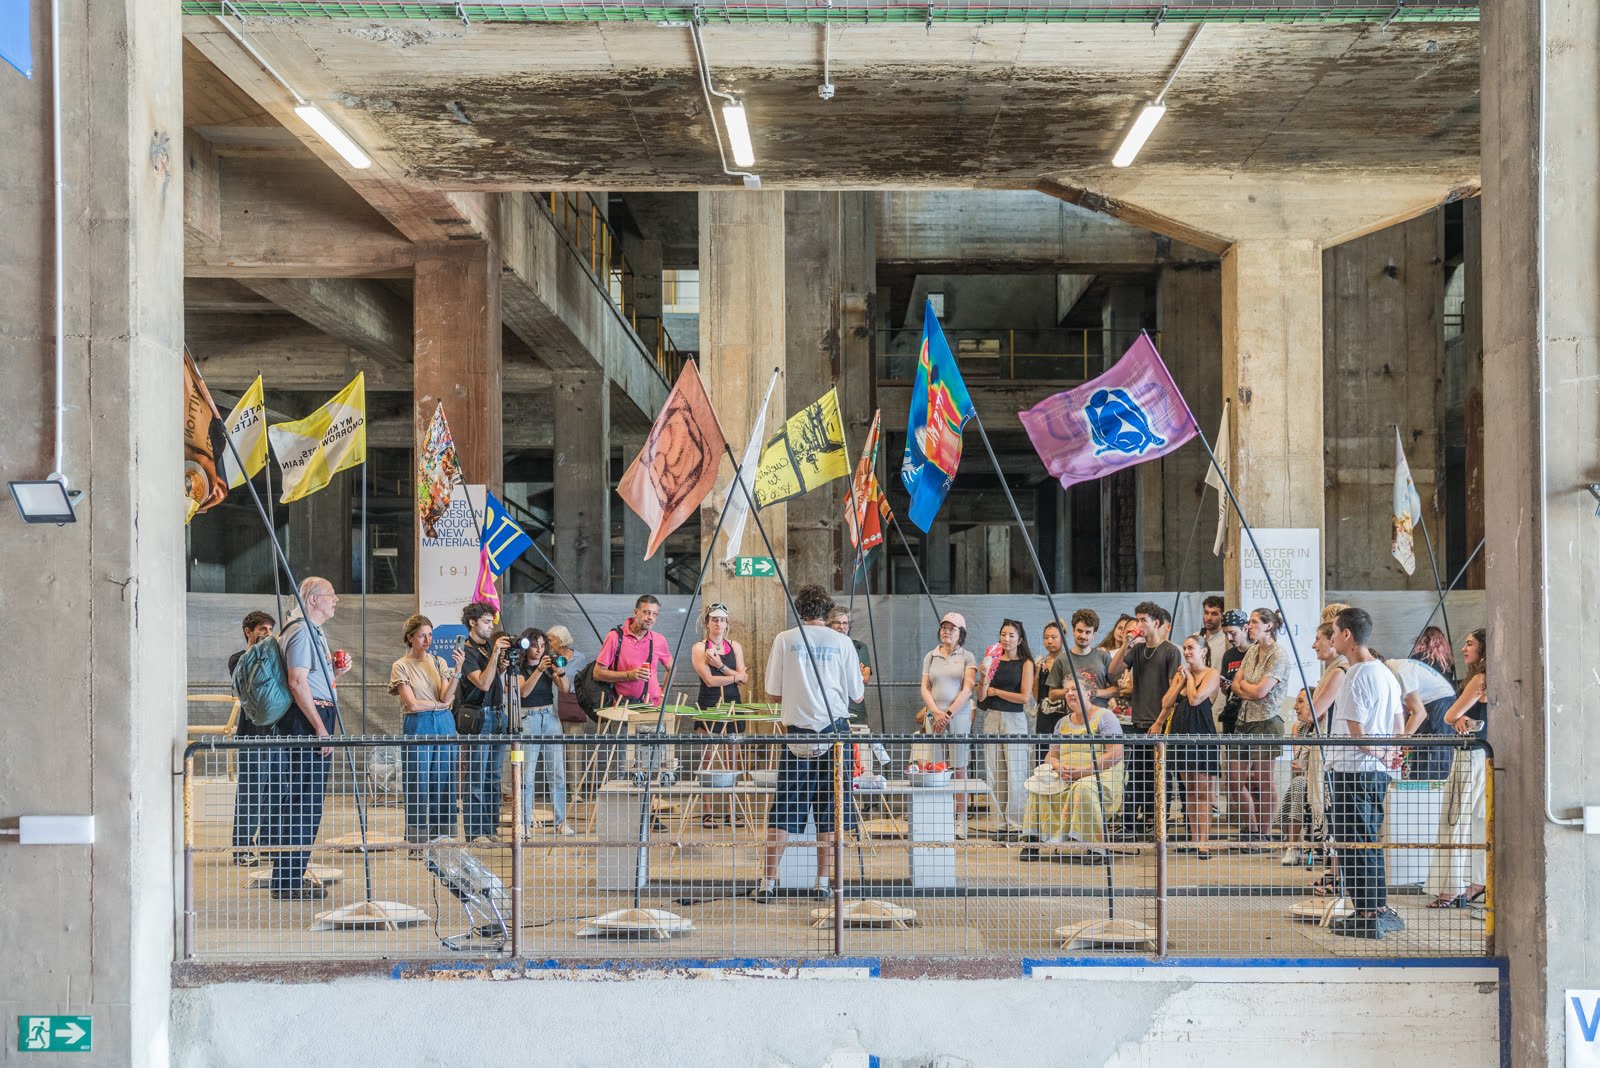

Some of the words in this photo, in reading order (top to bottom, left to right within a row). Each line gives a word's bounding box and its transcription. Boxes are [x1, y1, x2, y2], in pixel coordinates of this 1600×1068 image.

[442, 510, 483, 519] DESIGN
[434, 519, 475, 528] ROUGH
[438, 529, 465, 537] NEW
[422, 538, 481, 547] MATERIALS
[1297, 549, 1310, 558] IN
[1268, 569, 1293, 578] FOR
[1244, 579, 1313, 589] EMERGENT
